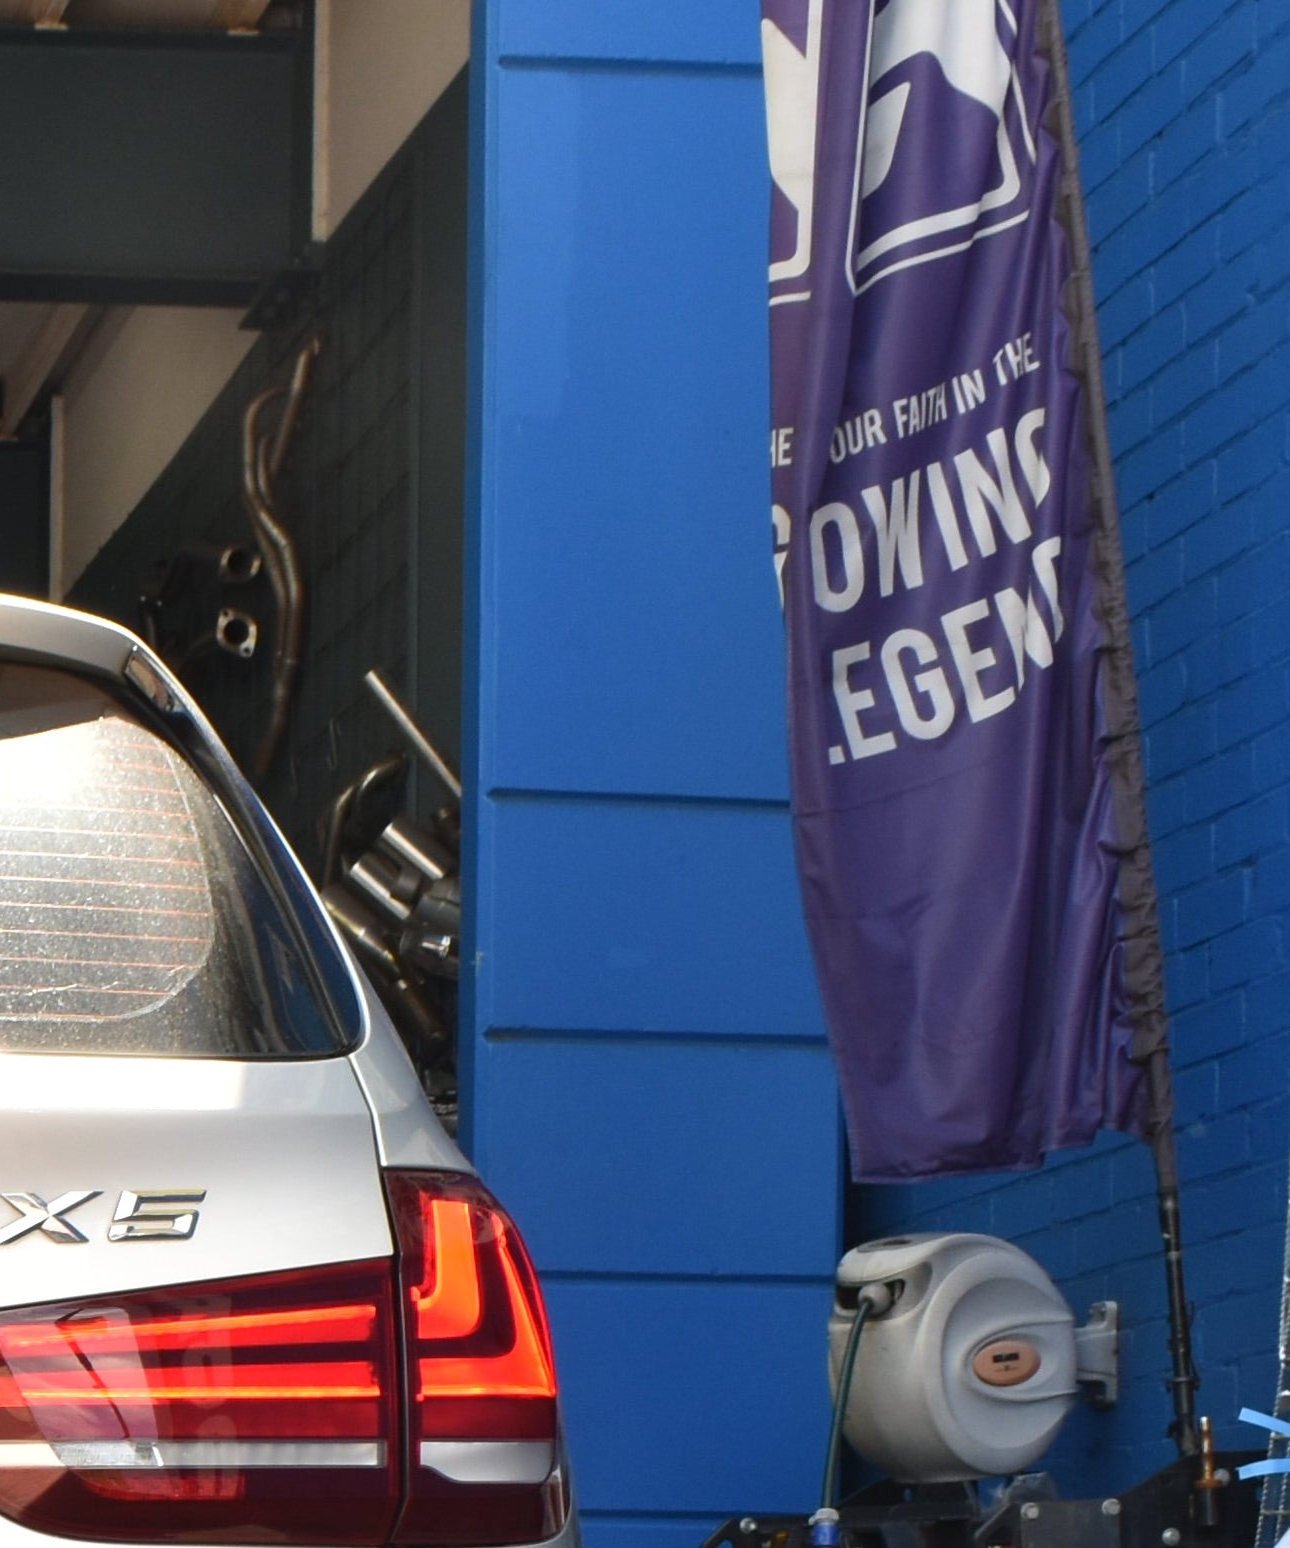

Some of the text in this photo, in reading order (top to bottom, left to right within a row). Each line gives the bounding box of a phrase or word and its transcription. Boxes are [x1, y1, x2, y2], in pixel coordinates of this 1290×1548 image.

[892, 381, 947, 440] FAITH
[951, 368, 986, 414] IN
[992, 332, 1041, 386] THE
